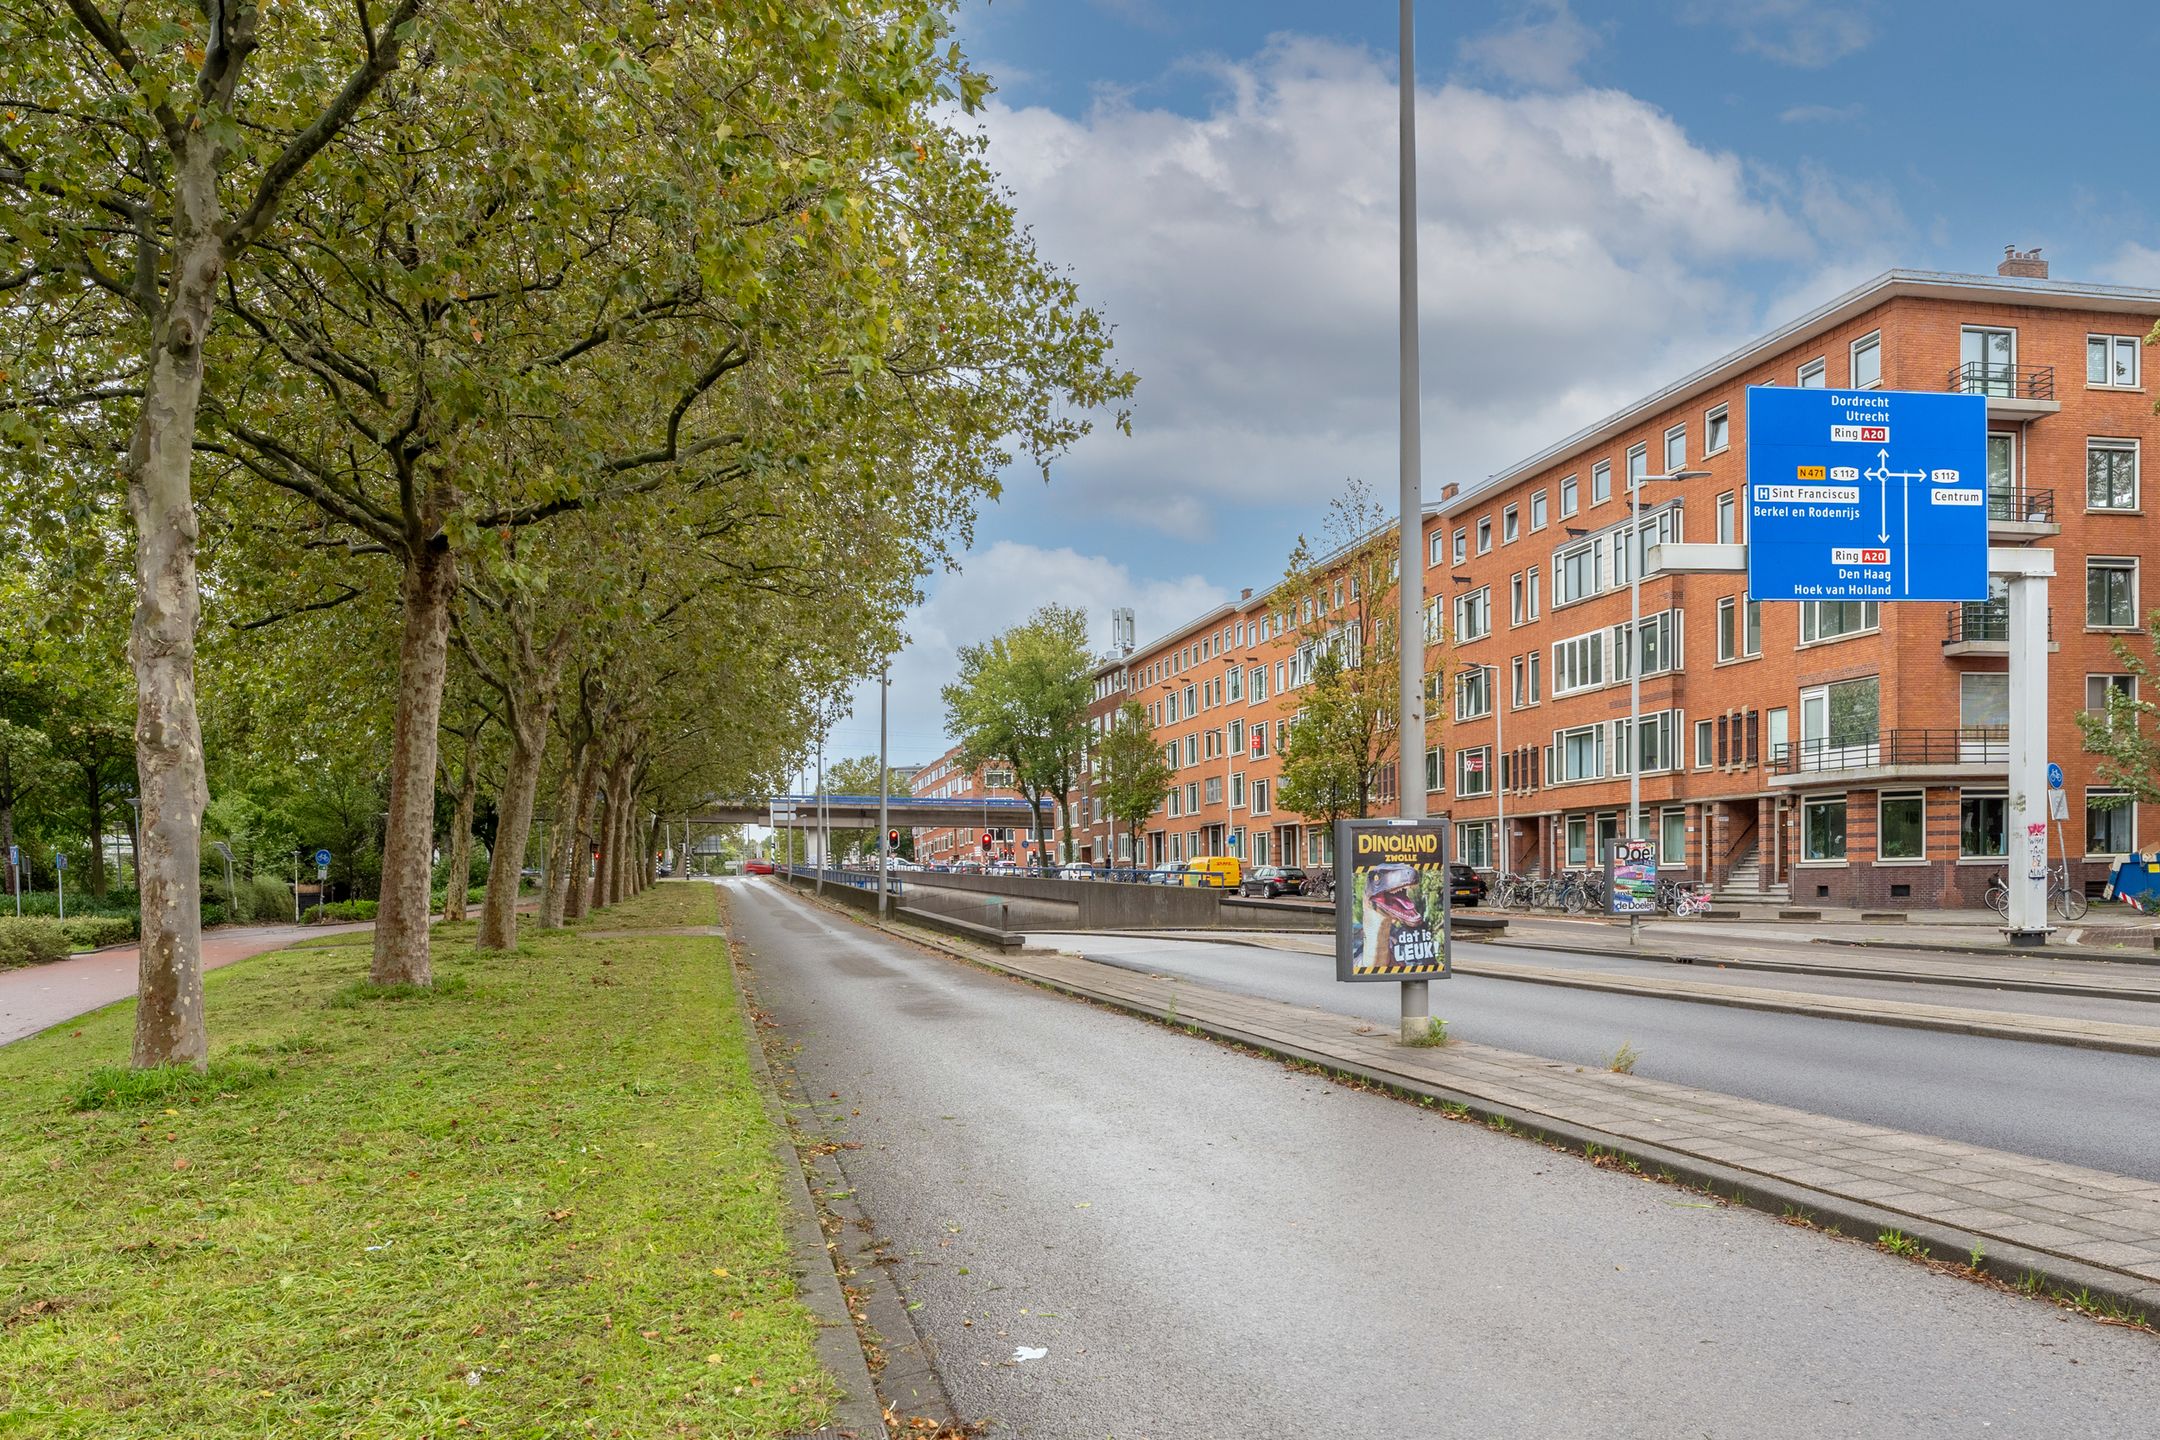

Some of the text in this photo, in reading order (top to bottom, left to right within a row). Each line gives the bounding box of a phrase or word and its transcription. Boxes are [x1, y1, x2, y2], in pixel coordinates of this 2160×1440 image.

[1831, 395, 1889, 407] Dordrecht
[1846, 410, 1889, 422] Utrecht
[1834, 427, 1884, 440] Ring A20
[1772, 487, 1794, 499] Sint
[1798, 488, 1856, 500] Franciscus
[1934, 491, 1979, 502] Centrum
[1754, 506, 1860, 520] Berkel en Rodenrijs
[1835, 550, 1885, 563] Ring A20
[1839, 568, 1891, 582] Den Haag
[1794, 584, 1891, 595] Hoek van Holland
[1358, 834, 1438, 854] DINOLAND
[1385, 854, 1418, 862] ZWOLLE
[1615, 845, 1654, 860] Doe!
[1616, 901, 1655, 910] de Doelen
[1398, 929, 1432, 944] dat is
[1394, 941, 1440, 962] LEUK!
